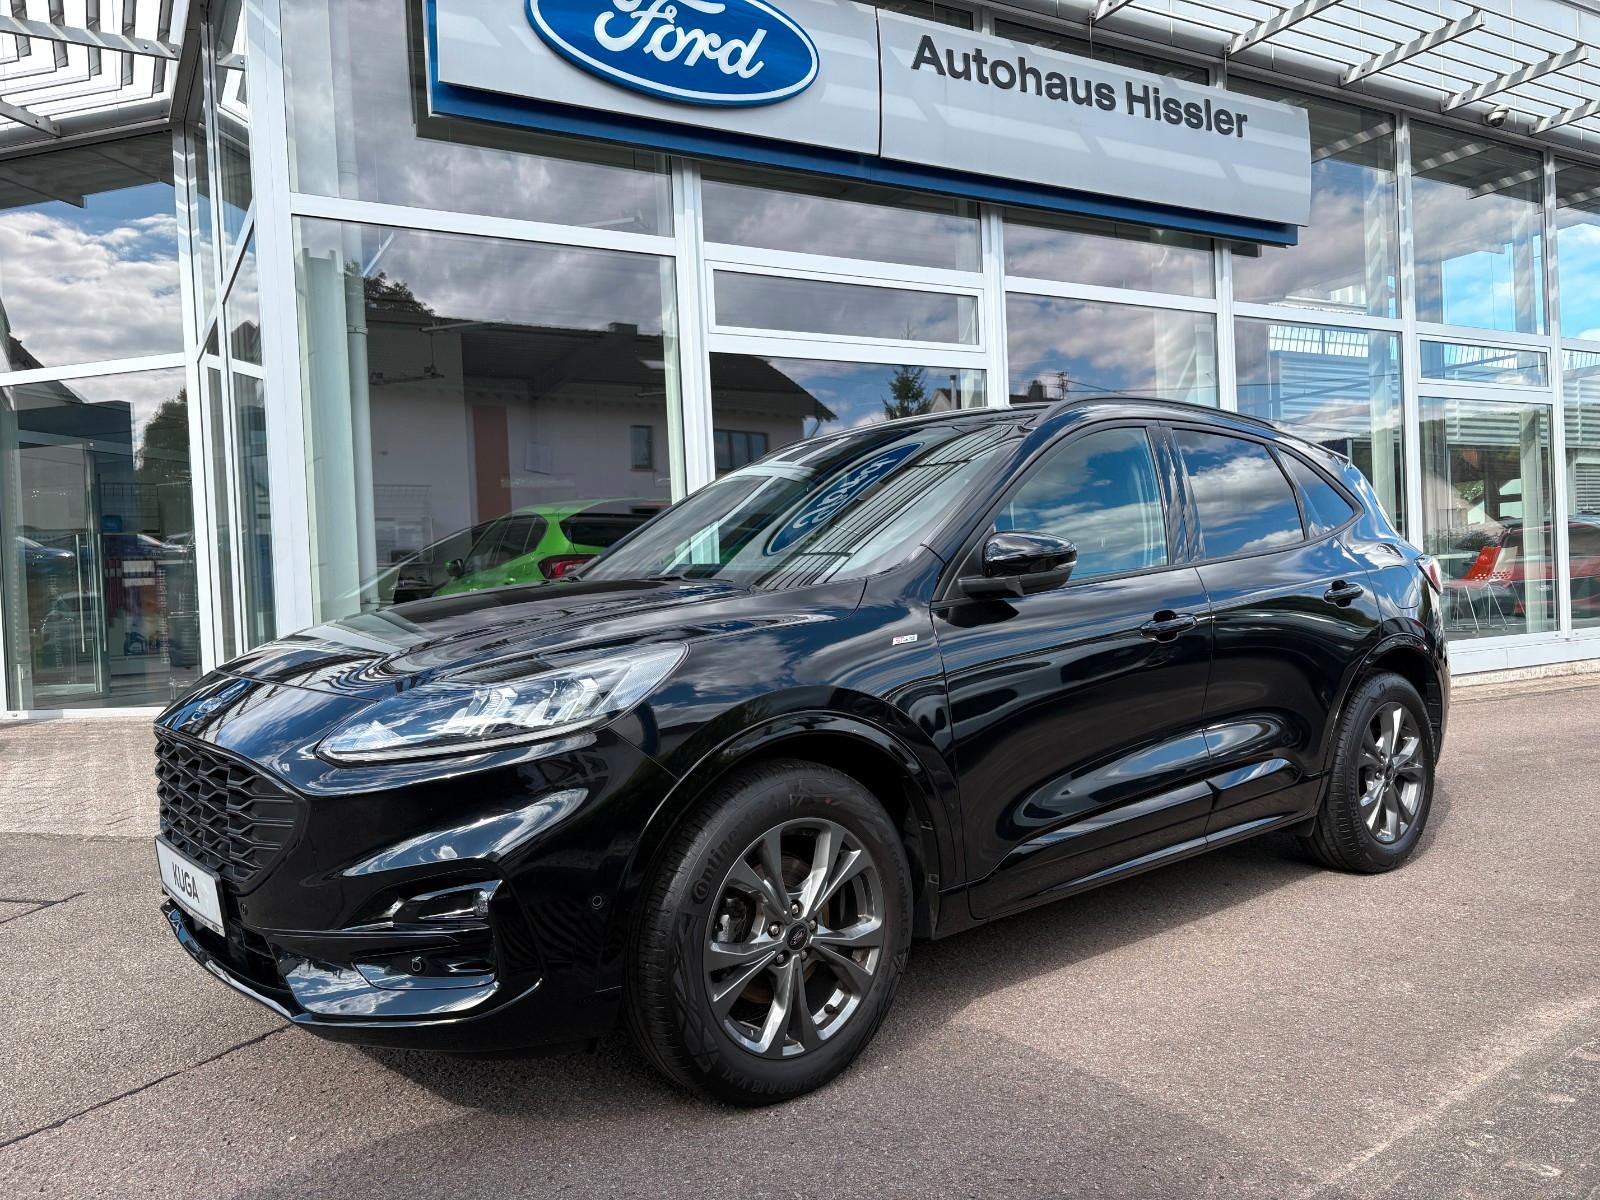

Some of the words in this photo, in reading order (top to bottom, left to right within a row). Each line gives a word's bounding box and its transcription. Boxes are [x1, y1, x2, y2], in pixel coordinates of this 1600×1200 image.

[594, 0, 767, 78] Ford
[911, 35, 1116, 111] Autohaus
[1125, 81, 1248, 138] Hissler
[173, 863, 200, 903] KUGA
